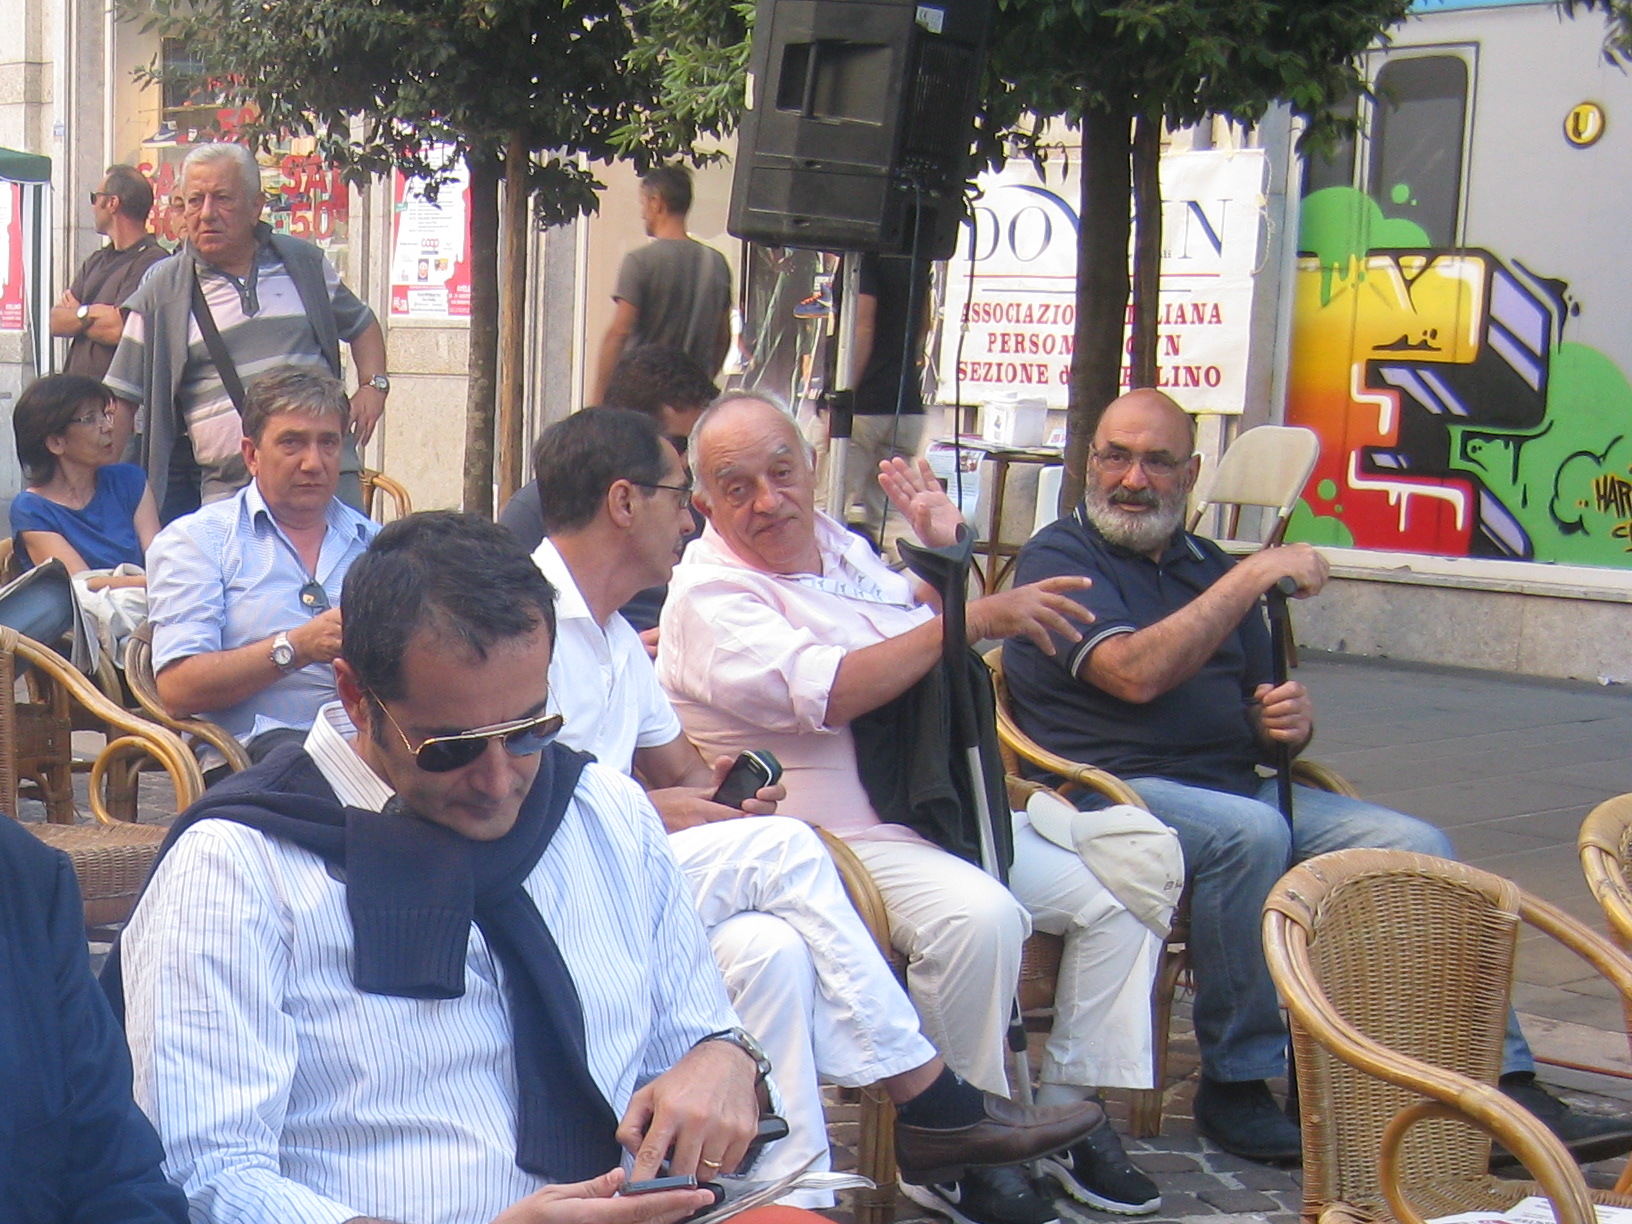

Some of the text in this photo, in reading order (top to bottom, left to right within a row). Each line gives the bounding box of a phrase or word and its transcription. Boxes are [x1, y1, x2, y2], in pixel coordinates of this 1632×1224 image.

[963, 198, 1233, 262] DON
[960, 302, 1075, 325] ASSOCIAZIO
[958, 361, 1048, 384] SEZIONE
